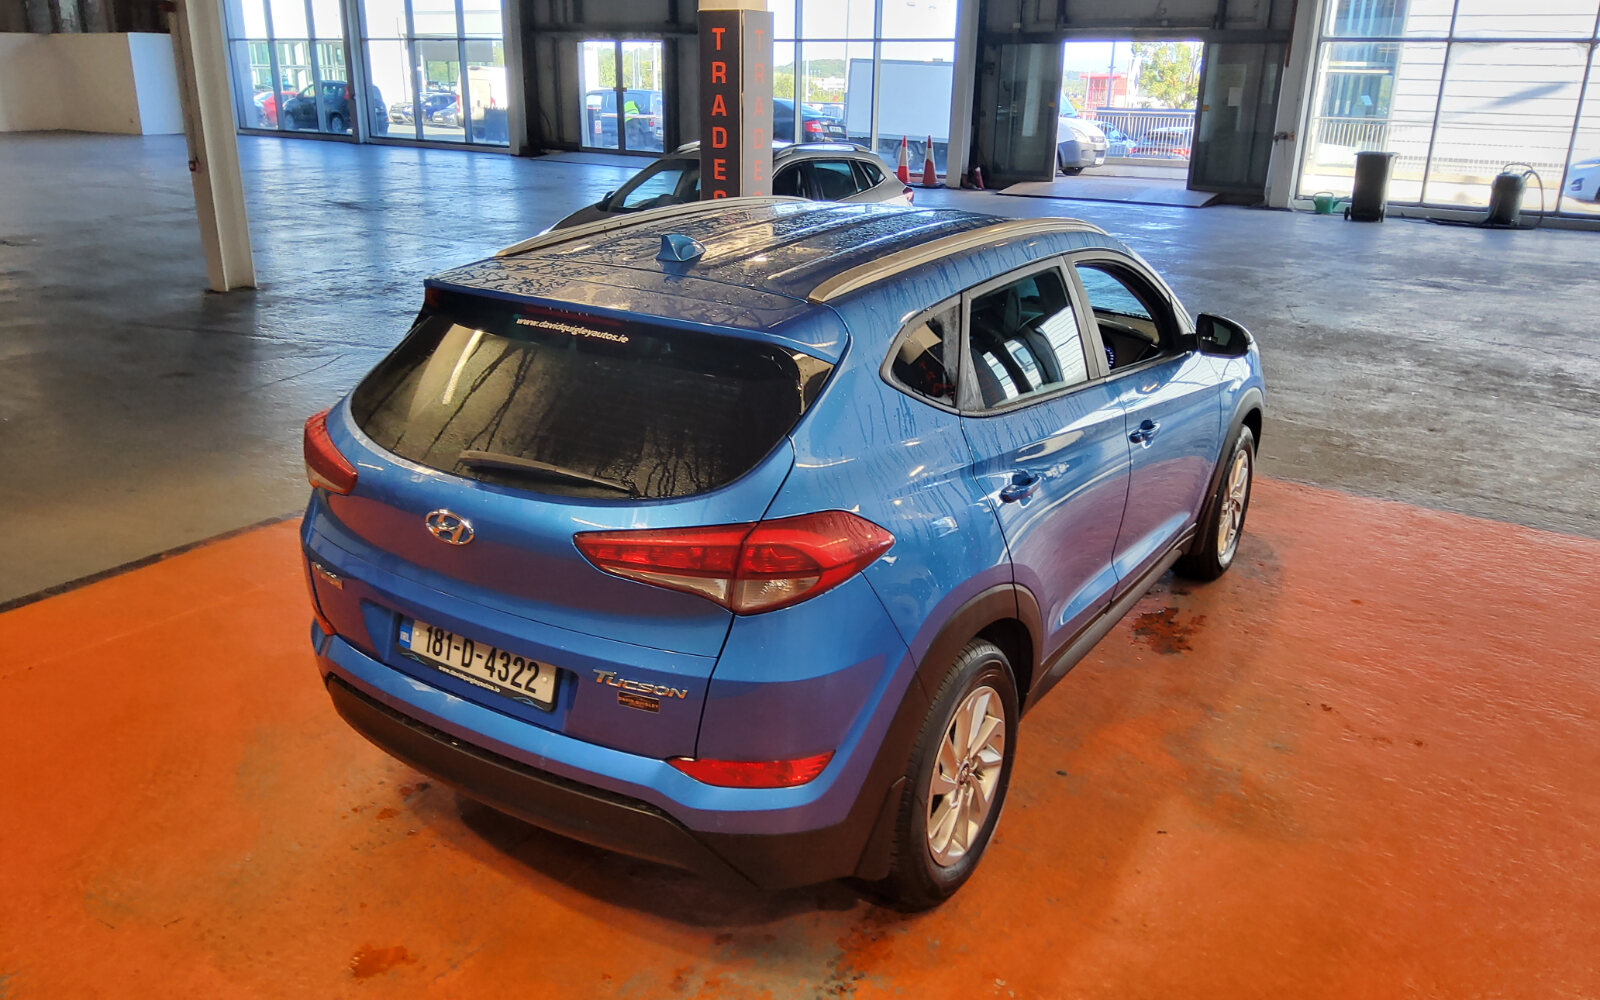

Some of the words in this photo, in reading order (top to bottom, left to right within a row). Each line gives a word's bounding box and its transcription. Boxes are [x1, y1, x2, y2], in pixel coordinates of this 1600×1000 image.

[516, 318, 629, 343] www.davidquigleyautos.ie
[426, 626, 540, 694] 181-D-4322
[593, 668, 688, 699] TUCSON
